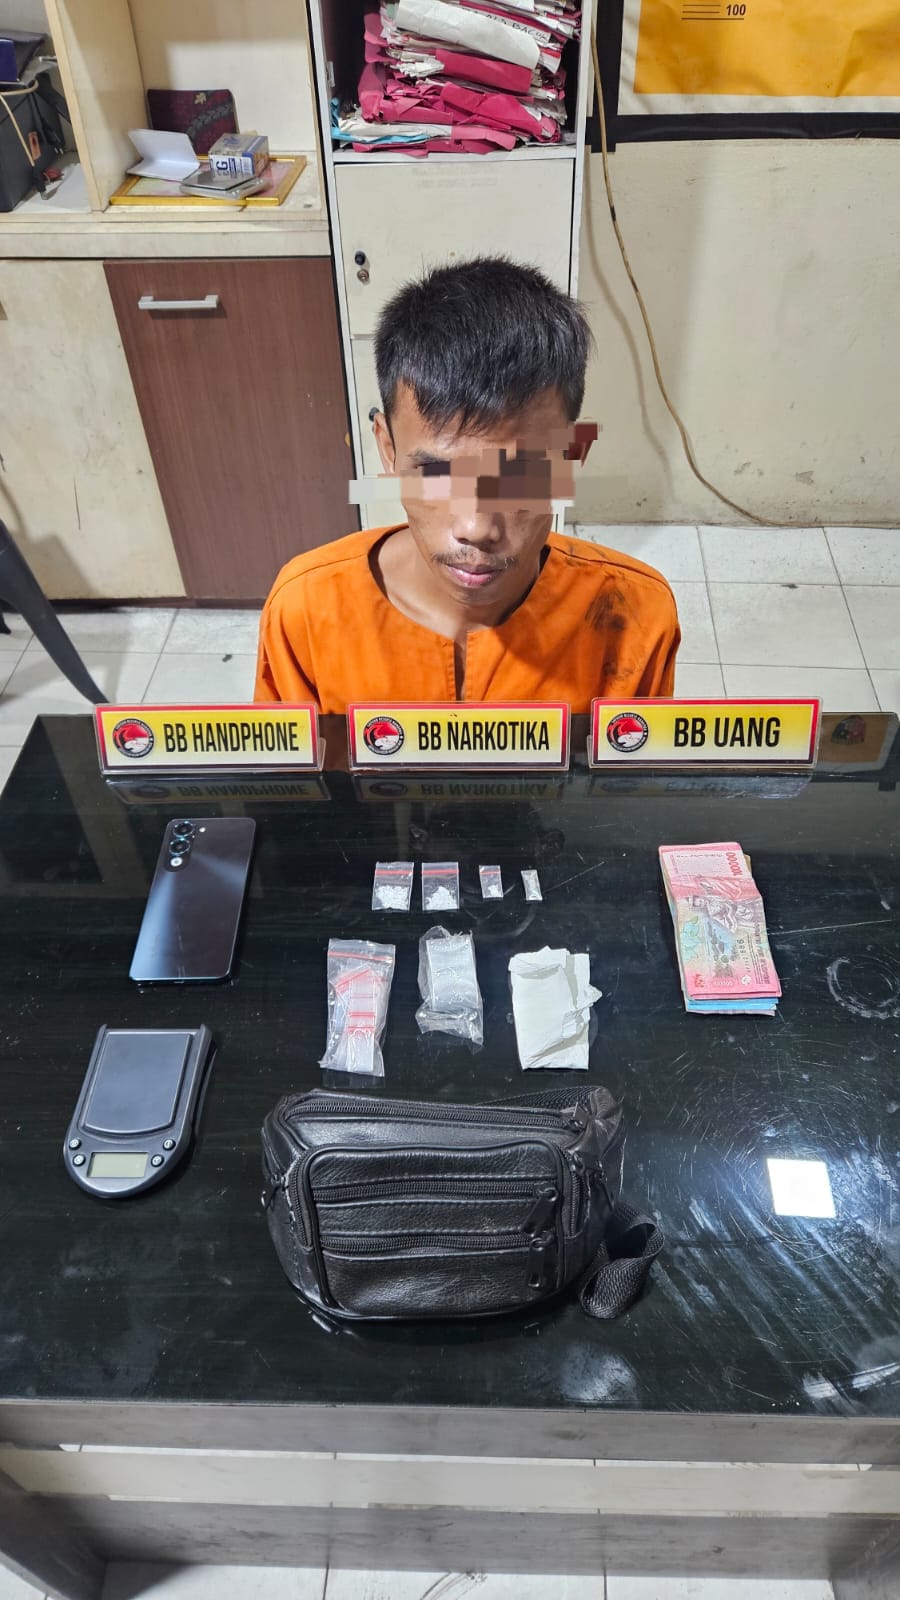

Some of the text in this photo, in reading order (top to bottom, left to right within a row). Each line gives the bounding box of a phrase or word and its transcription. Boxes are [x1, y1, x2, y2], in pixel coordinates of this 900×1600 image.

[726, 4, 746, 16] 100
[163, 723, 188, 753] BB
[192, 721, 300, 752] HANDPHONE
[418, 721, 442, 751] BB
[447, 721, 550, 751] NARKOTIKA
[674, 717, 706, 748] BB
[714, 717, 781, 748] UANG
